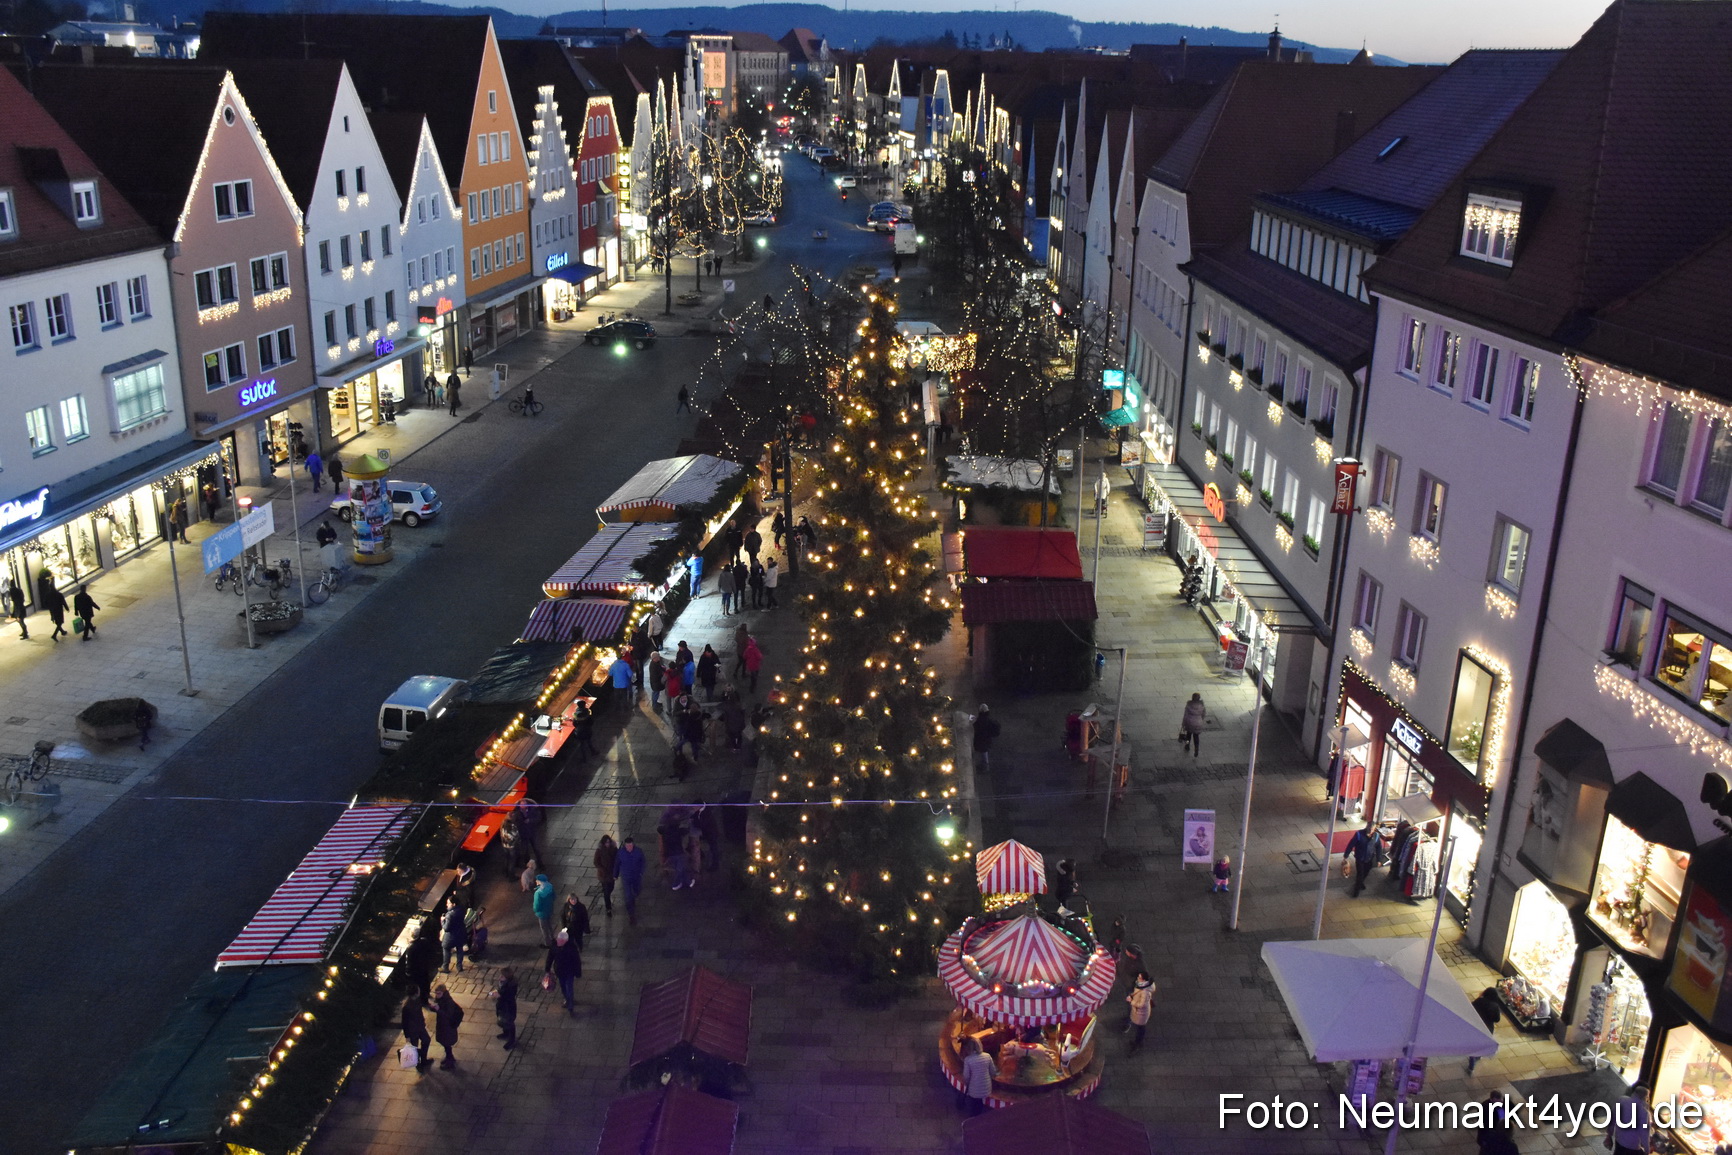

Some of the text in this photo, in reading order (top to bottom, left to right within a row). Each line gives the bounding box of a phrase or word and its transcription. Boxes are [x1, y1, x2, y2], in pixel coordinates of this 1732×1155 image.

[619, 151, 631, 213] HOTEL
[375, 336, 395, 357] Fries
[1390, 717, 1423, 755] Achatz
